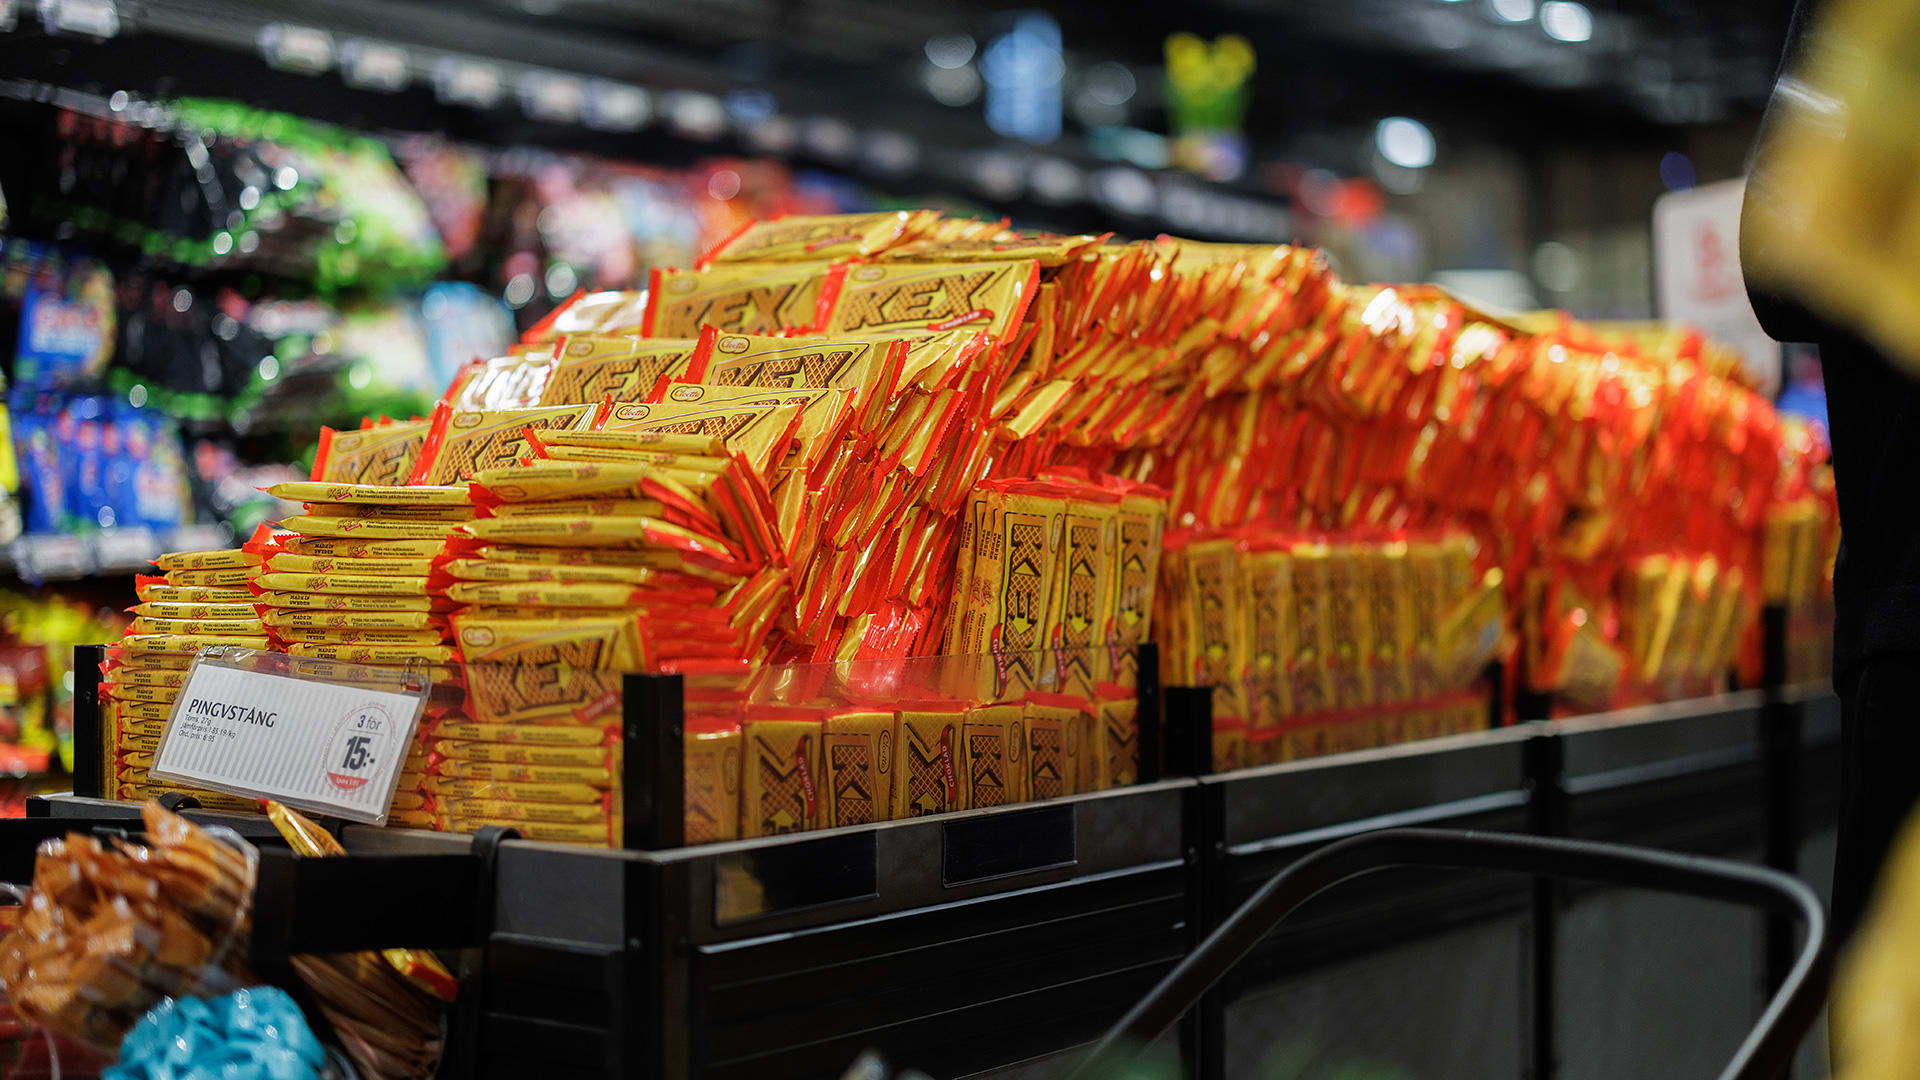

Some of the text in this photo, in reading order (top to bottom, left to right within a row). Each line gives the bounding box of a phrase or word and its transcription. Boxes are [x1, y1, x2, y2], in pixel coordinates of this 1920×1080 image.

[666, 283, 797, 338] KEX
[844, 271, 995, 332] KEX
[721, 339, 747, 350] Cloetta
[550, 352, 682, 405] KEX
[674, 388, 700, 399] Cloetta
[619, 406, 646, 418] Cloetta
[1003, 523, 1043, 681] KEX
[1066, 525, 1099, 680] KEX
[474, 638, 606, 717] KEX
[201, 716, 212, 727] 27g
[357, 714, 367, 729] 3
[342, 735, 376, 771] 15:-
[942, 744, 956, 789] CHOKLAD
